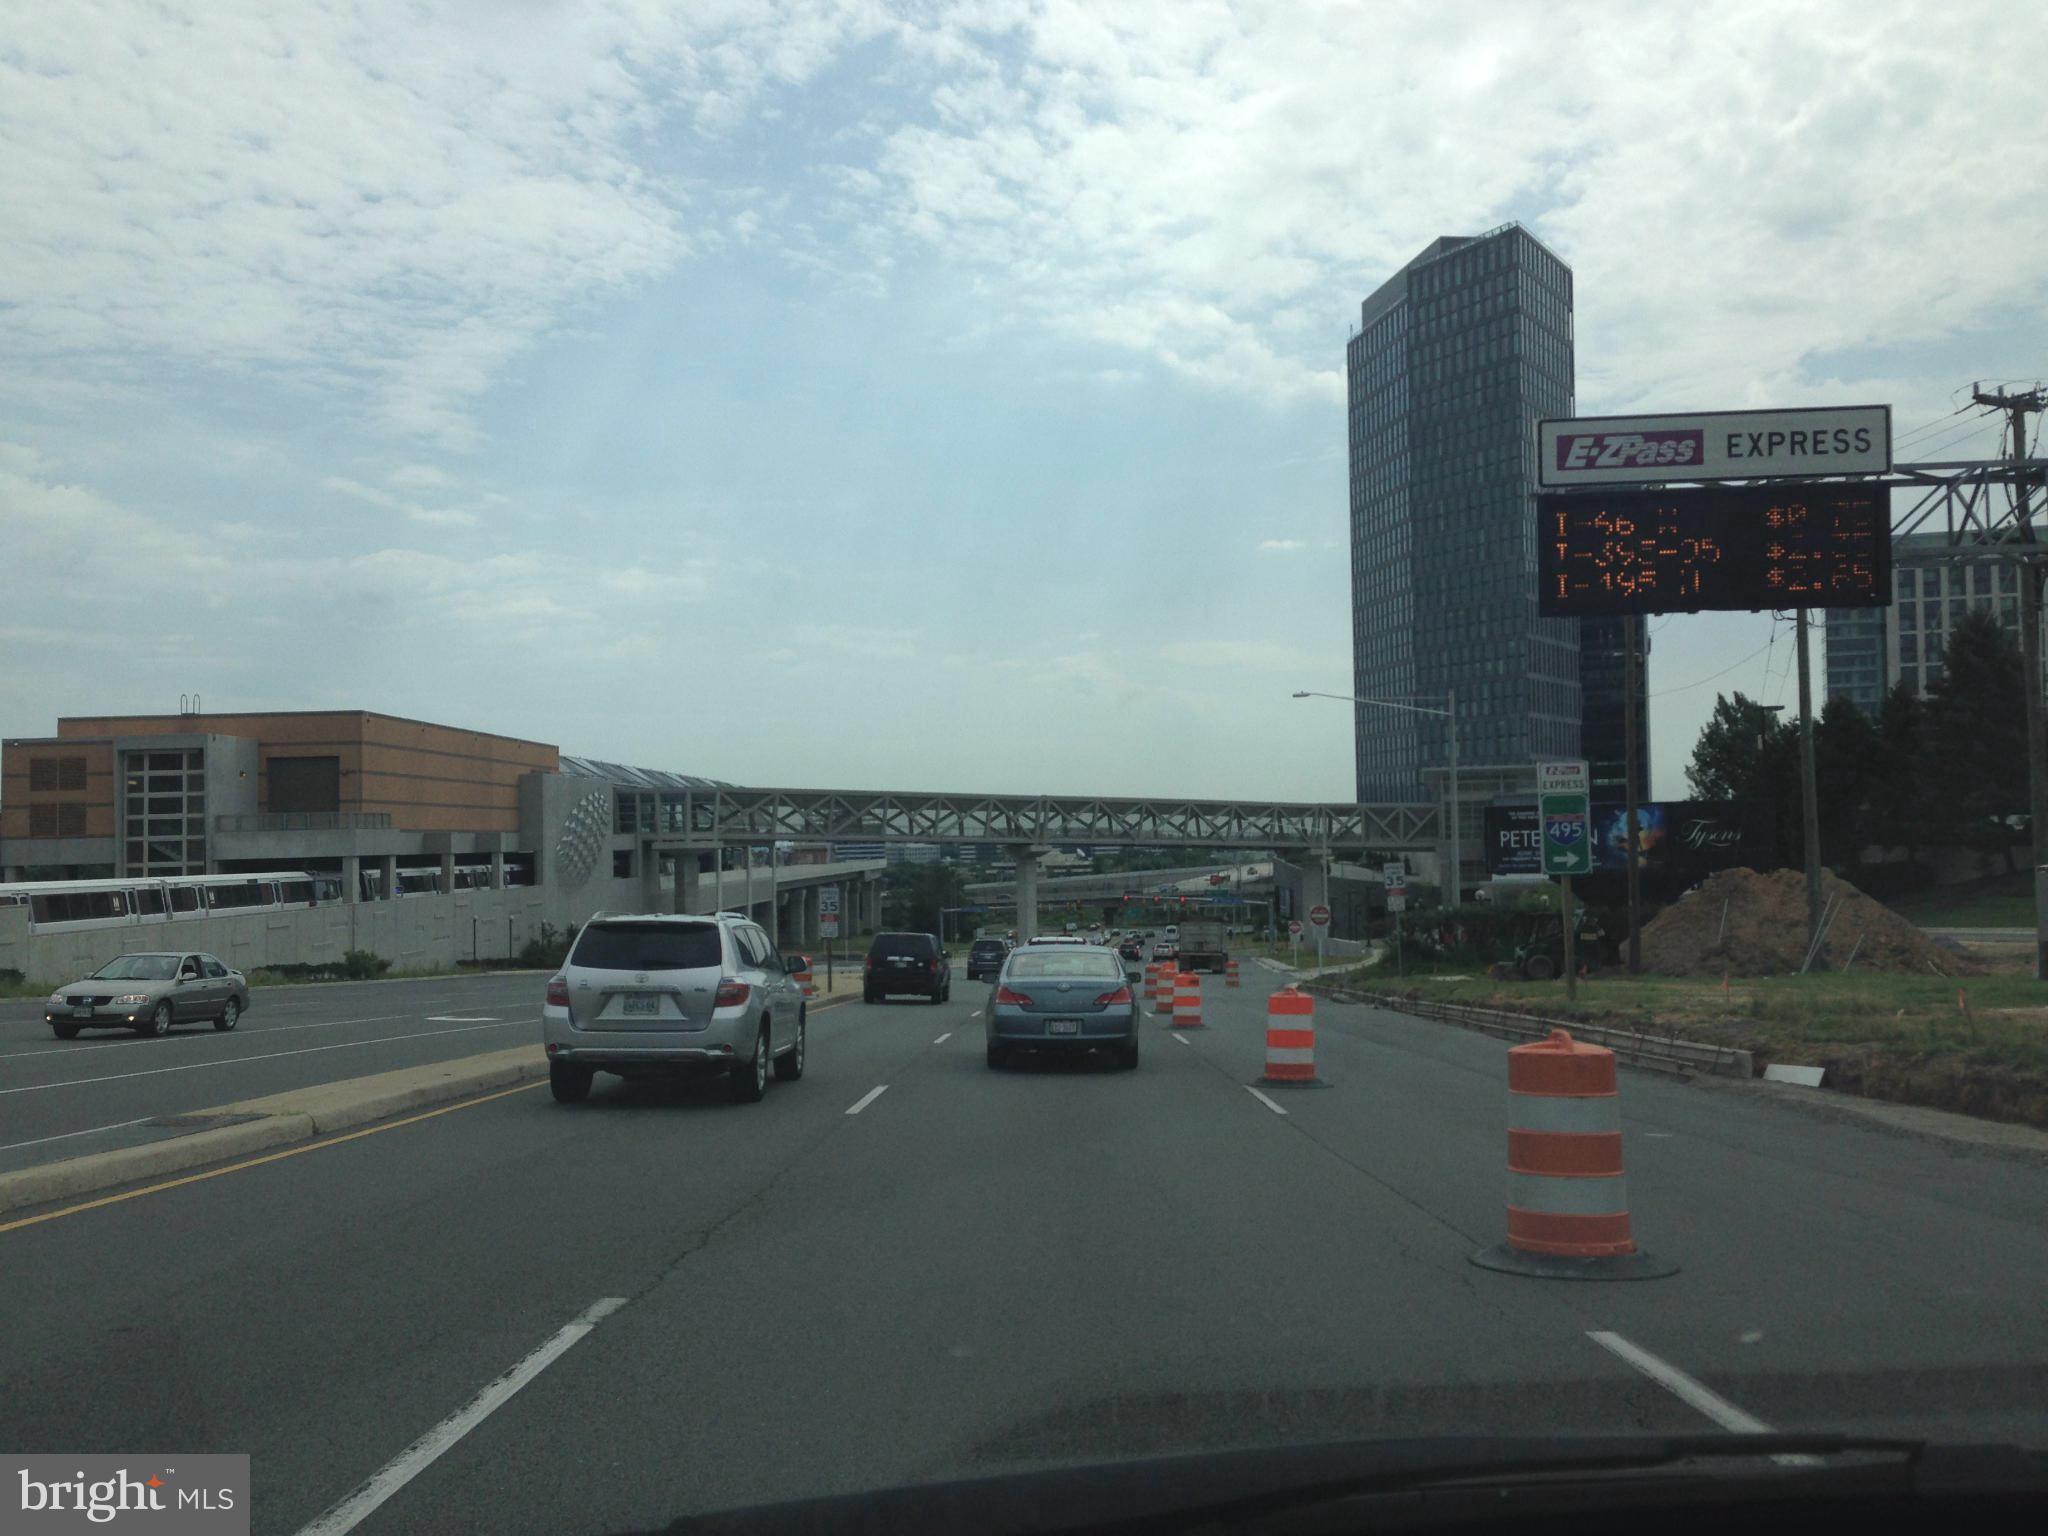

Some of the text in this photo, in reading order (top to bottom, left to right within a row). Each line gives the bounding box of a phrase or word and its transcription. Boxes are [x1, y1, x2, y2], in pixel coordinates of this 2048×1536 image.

[1564, 427, 1872, 469] E-ZPass EXPRESS
[1543, 779, 1585, 790] EXPRESS
[1550, 822, 1583, 838] 495
[1500, 829, 1541, 848] PETE
[1386, 875, 1404, 886] 35
[822, 901, 838, 912] 35
